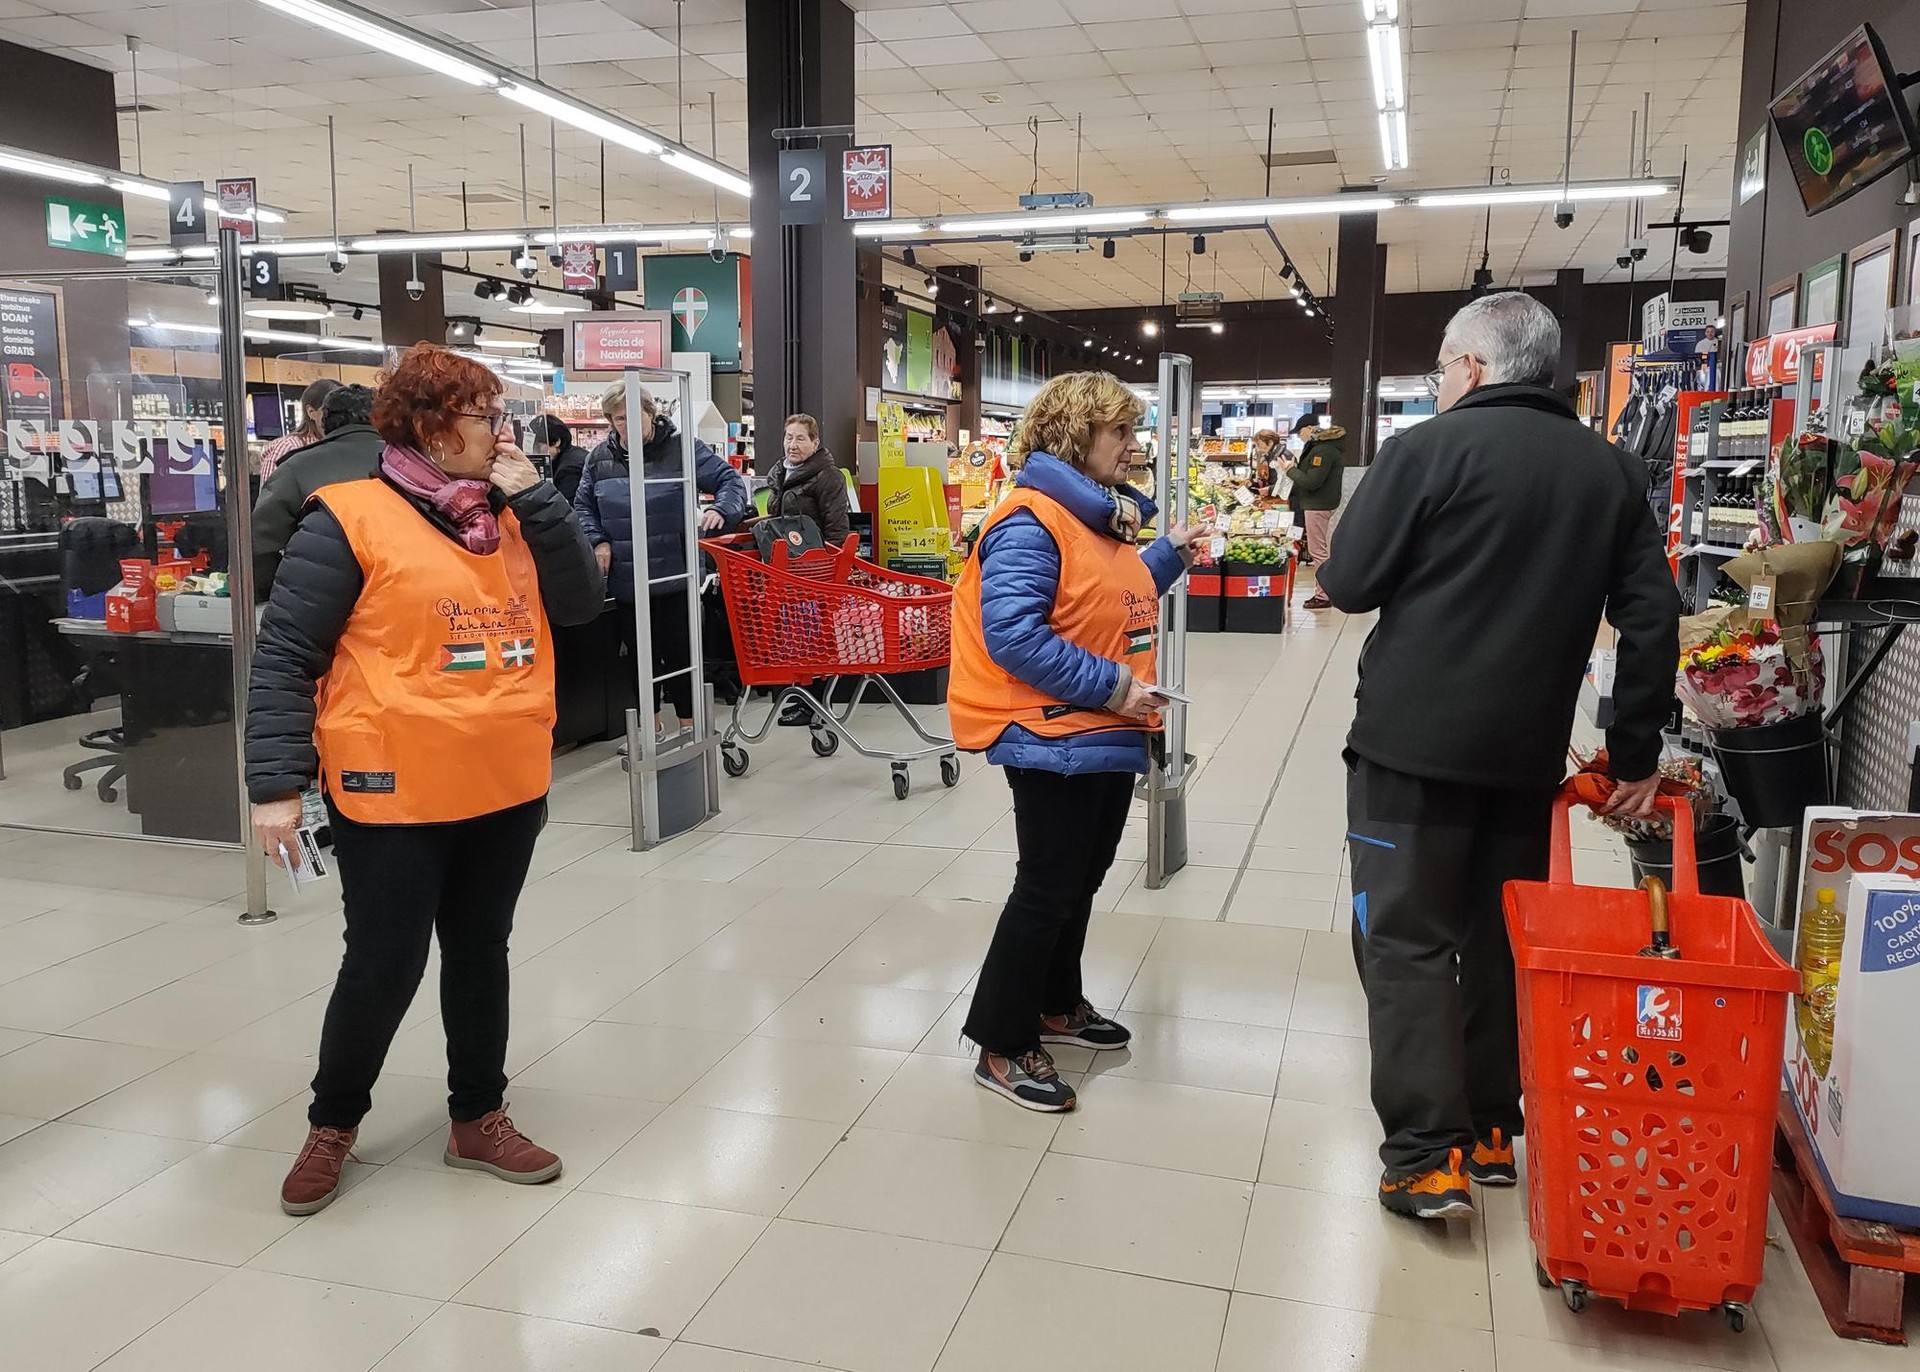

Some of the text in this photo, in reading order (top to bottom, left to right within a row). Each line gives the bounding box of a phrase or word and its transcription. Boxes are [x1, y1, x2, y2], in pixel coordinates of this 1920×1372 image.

[789, 166, 812, 202] 2
[176, 197, 196, 228] 4
[255, 260, 271, 285] 3
[613, 251, 624, 276] 1
[1671, 316, 1707, 327] CAPRI
[4, 346, 35, 356] GRATIS
[600, 337, 645, 348] Cesta de
[600, 350, 644, 360] Navidad
[913, 538, 926, 547] 14
[449, 617, 506, 632] Sahara
[1811, 829, 1920, 879] SOS
[1873, 899, 1920, 933] 100%
[1887, 920, 1920, 949] CART
